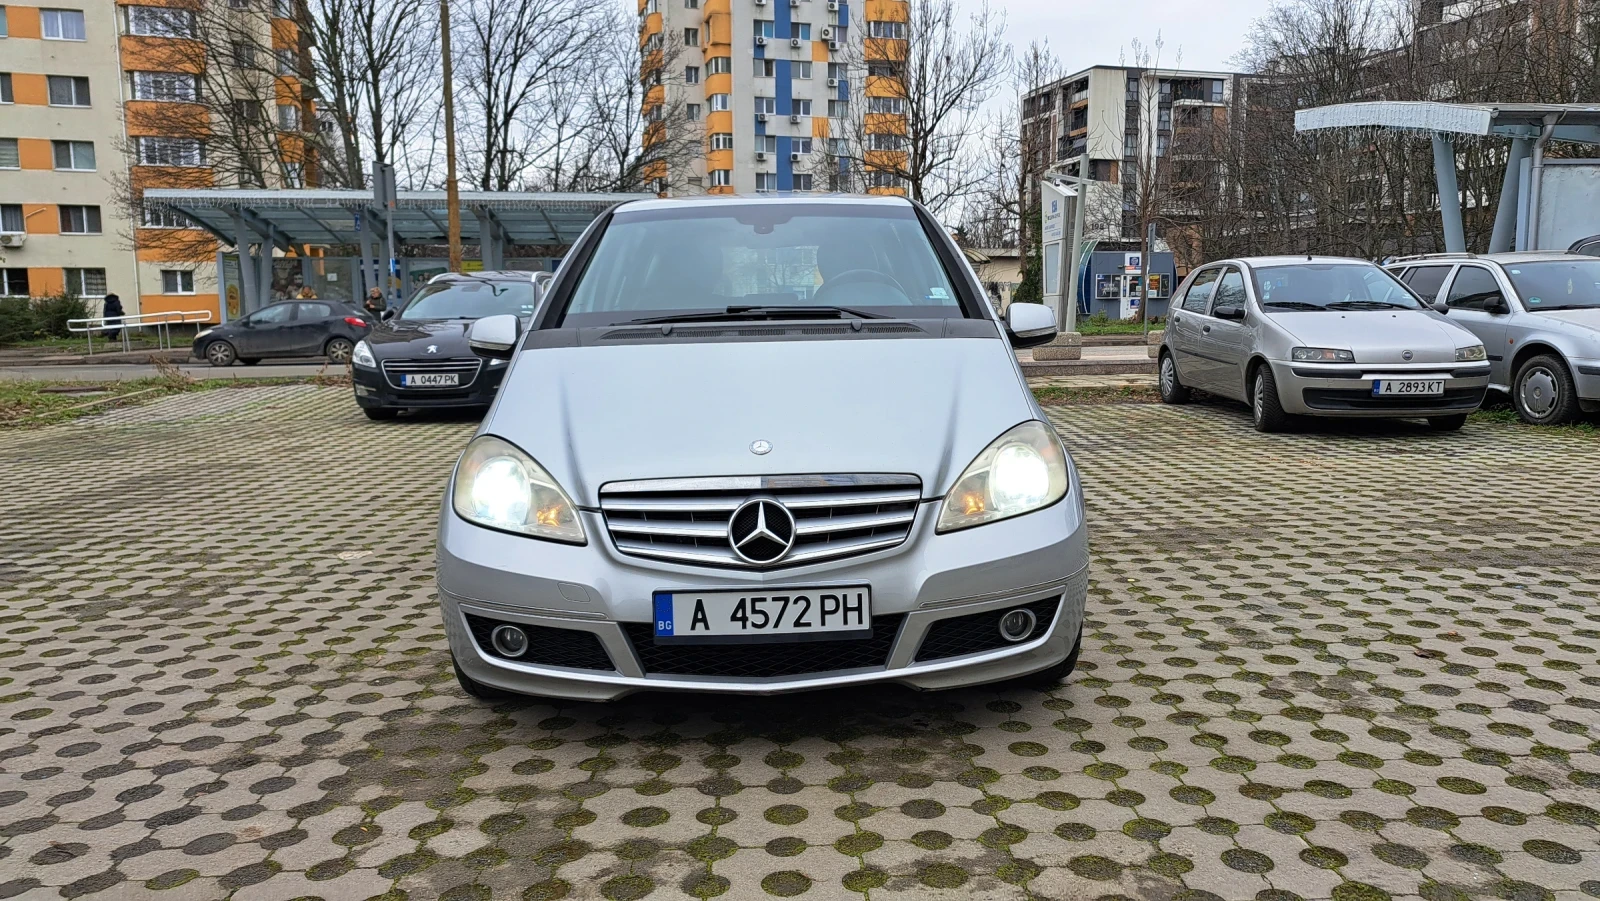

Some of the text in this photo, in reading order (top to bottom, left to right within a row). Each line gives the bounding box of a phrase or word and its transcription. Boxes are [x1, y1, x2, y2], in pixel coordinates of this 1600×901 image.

[411, 376, 416, 384] A
[1385, 382, 1392, 392] A
[690, 599, 710, 631] A
[658, 621, 672, 630] BG
